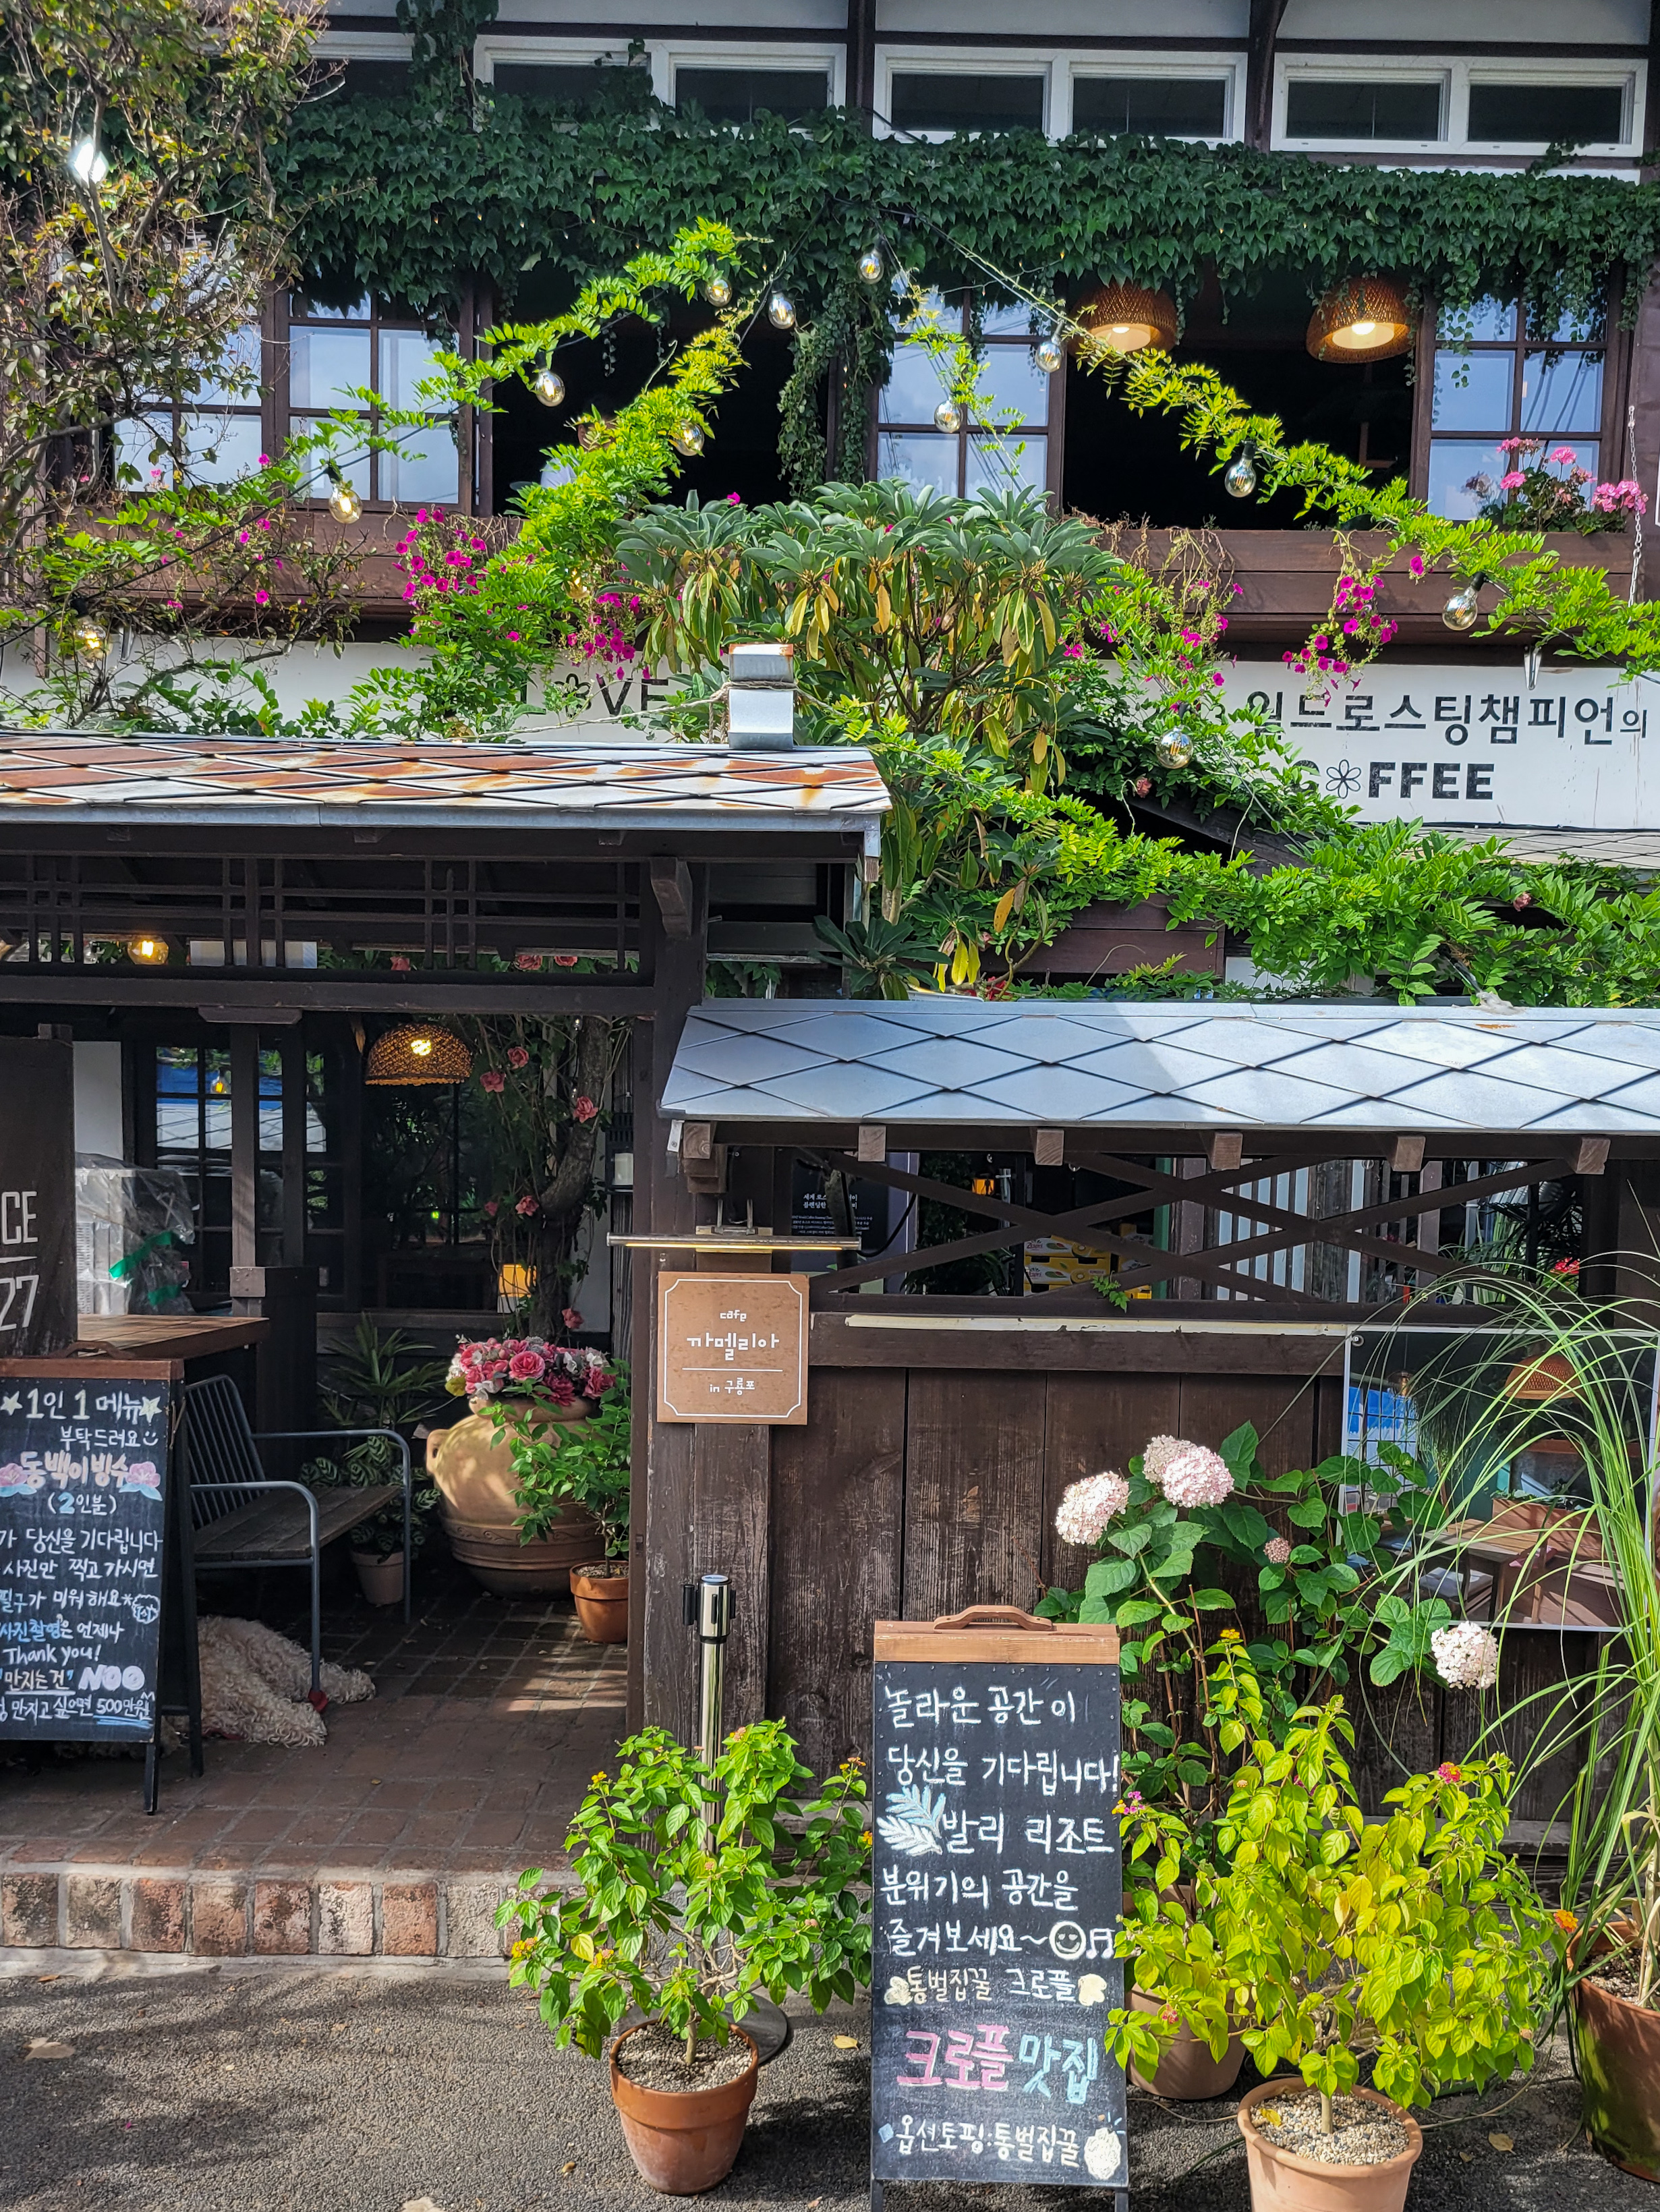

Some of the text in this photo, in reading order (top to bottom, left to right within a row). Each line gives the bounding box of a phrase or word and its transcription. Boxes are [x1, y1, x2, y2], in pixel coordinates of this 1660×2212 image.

[720, 1309, 747, 1322] cafe
[710, 1378, 755, 1396] in 구룡포
[60, 1425, 141, 1451] 부탁드려요
[48, 1492, 117, 1516] (2인분)
[26, 1527, 77, 1554] 당신을
[80, 1528, 163, 1555] 기다립니다
[3, 1558, 59, 1580] 사진만
[77, 1620, 125, 1644] 언제나
[3, 1643, 101, 1666] Thank you!
[885, 1685, 981, 1729] 놀라운
[888, 1744, 1120, 1796] 당신을 기다립니다!
[942, 1808, 1114, 1854] 발리 리조트
[880, 1864, 1079, 1910] 분위기의 공간을
[907, 1965, 1077, 2005] 통벌집꿀 크로플
[896, 2024, 1099, 2105] 크로플 맛집
